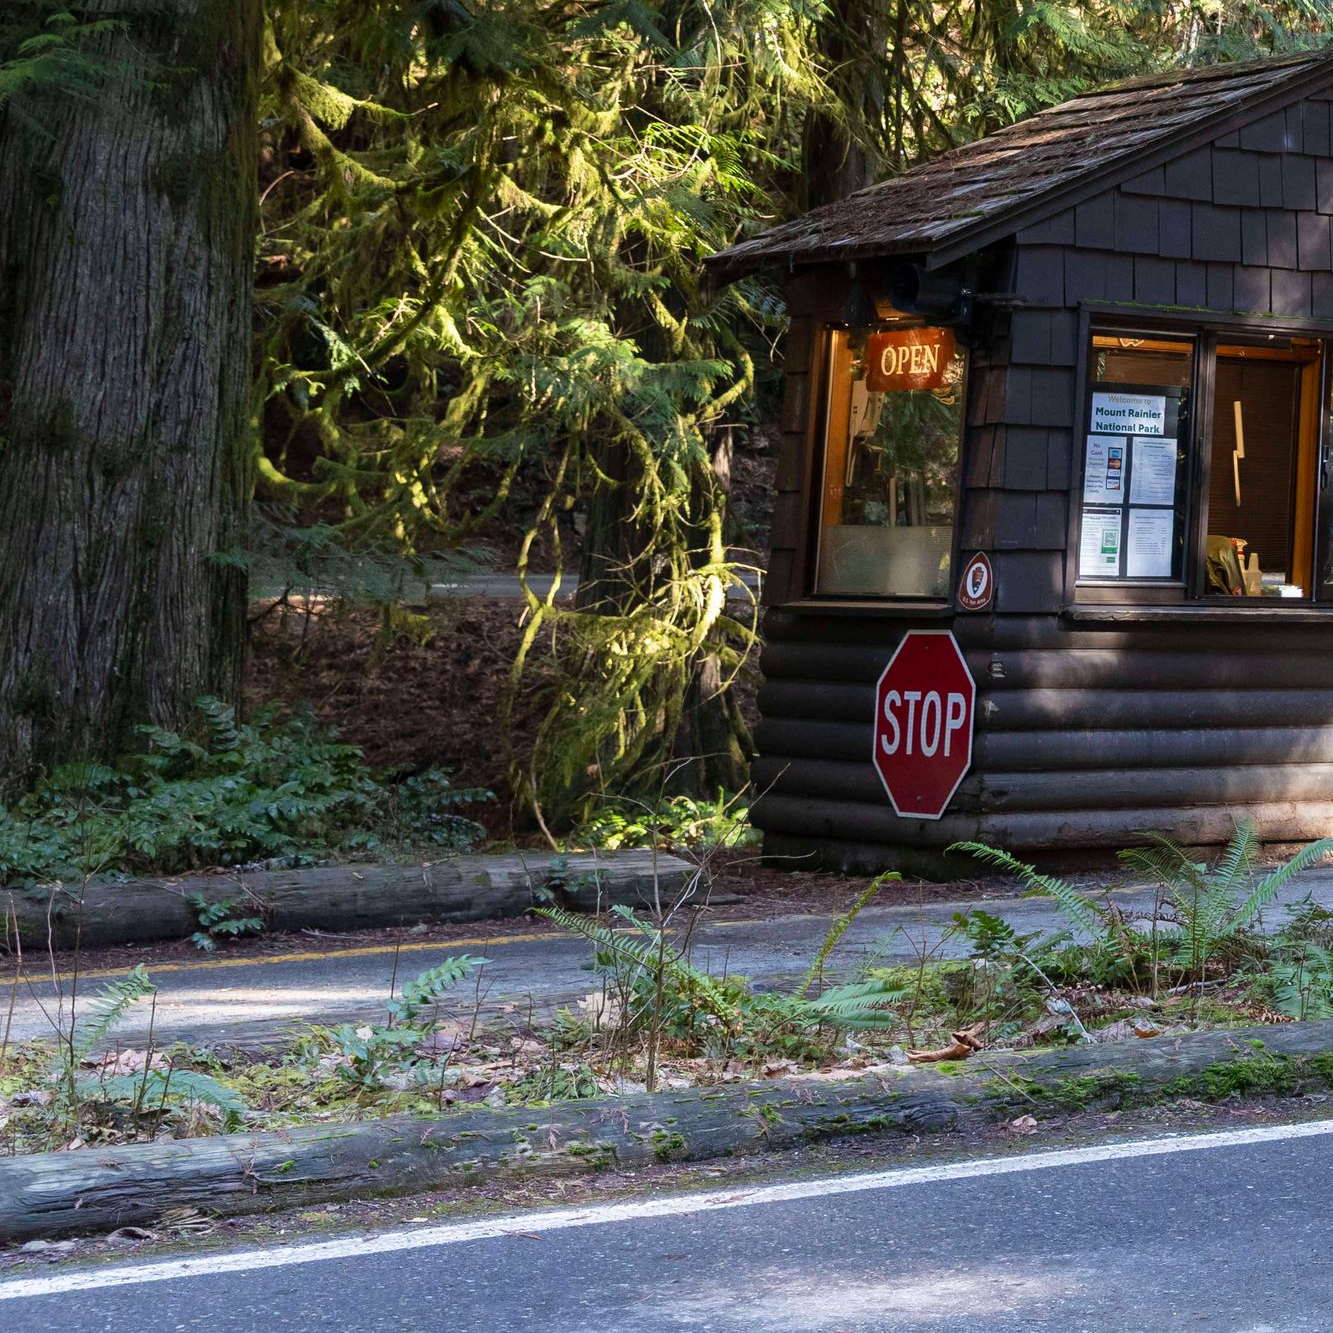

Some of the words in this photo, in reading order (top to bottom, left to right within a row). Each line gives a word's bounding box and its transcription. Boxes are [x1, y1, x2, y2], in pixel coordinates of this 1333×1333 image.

[881, 344, 940, 376] OPEN
[1096, 407, 1125, 416] Mount
[1128, 409, 1161, 419] Rainier
[1096, 422, 1136, 432] National
[1138, 424, 1159, 433] Park
[881, 689, 966, 758] STOP
